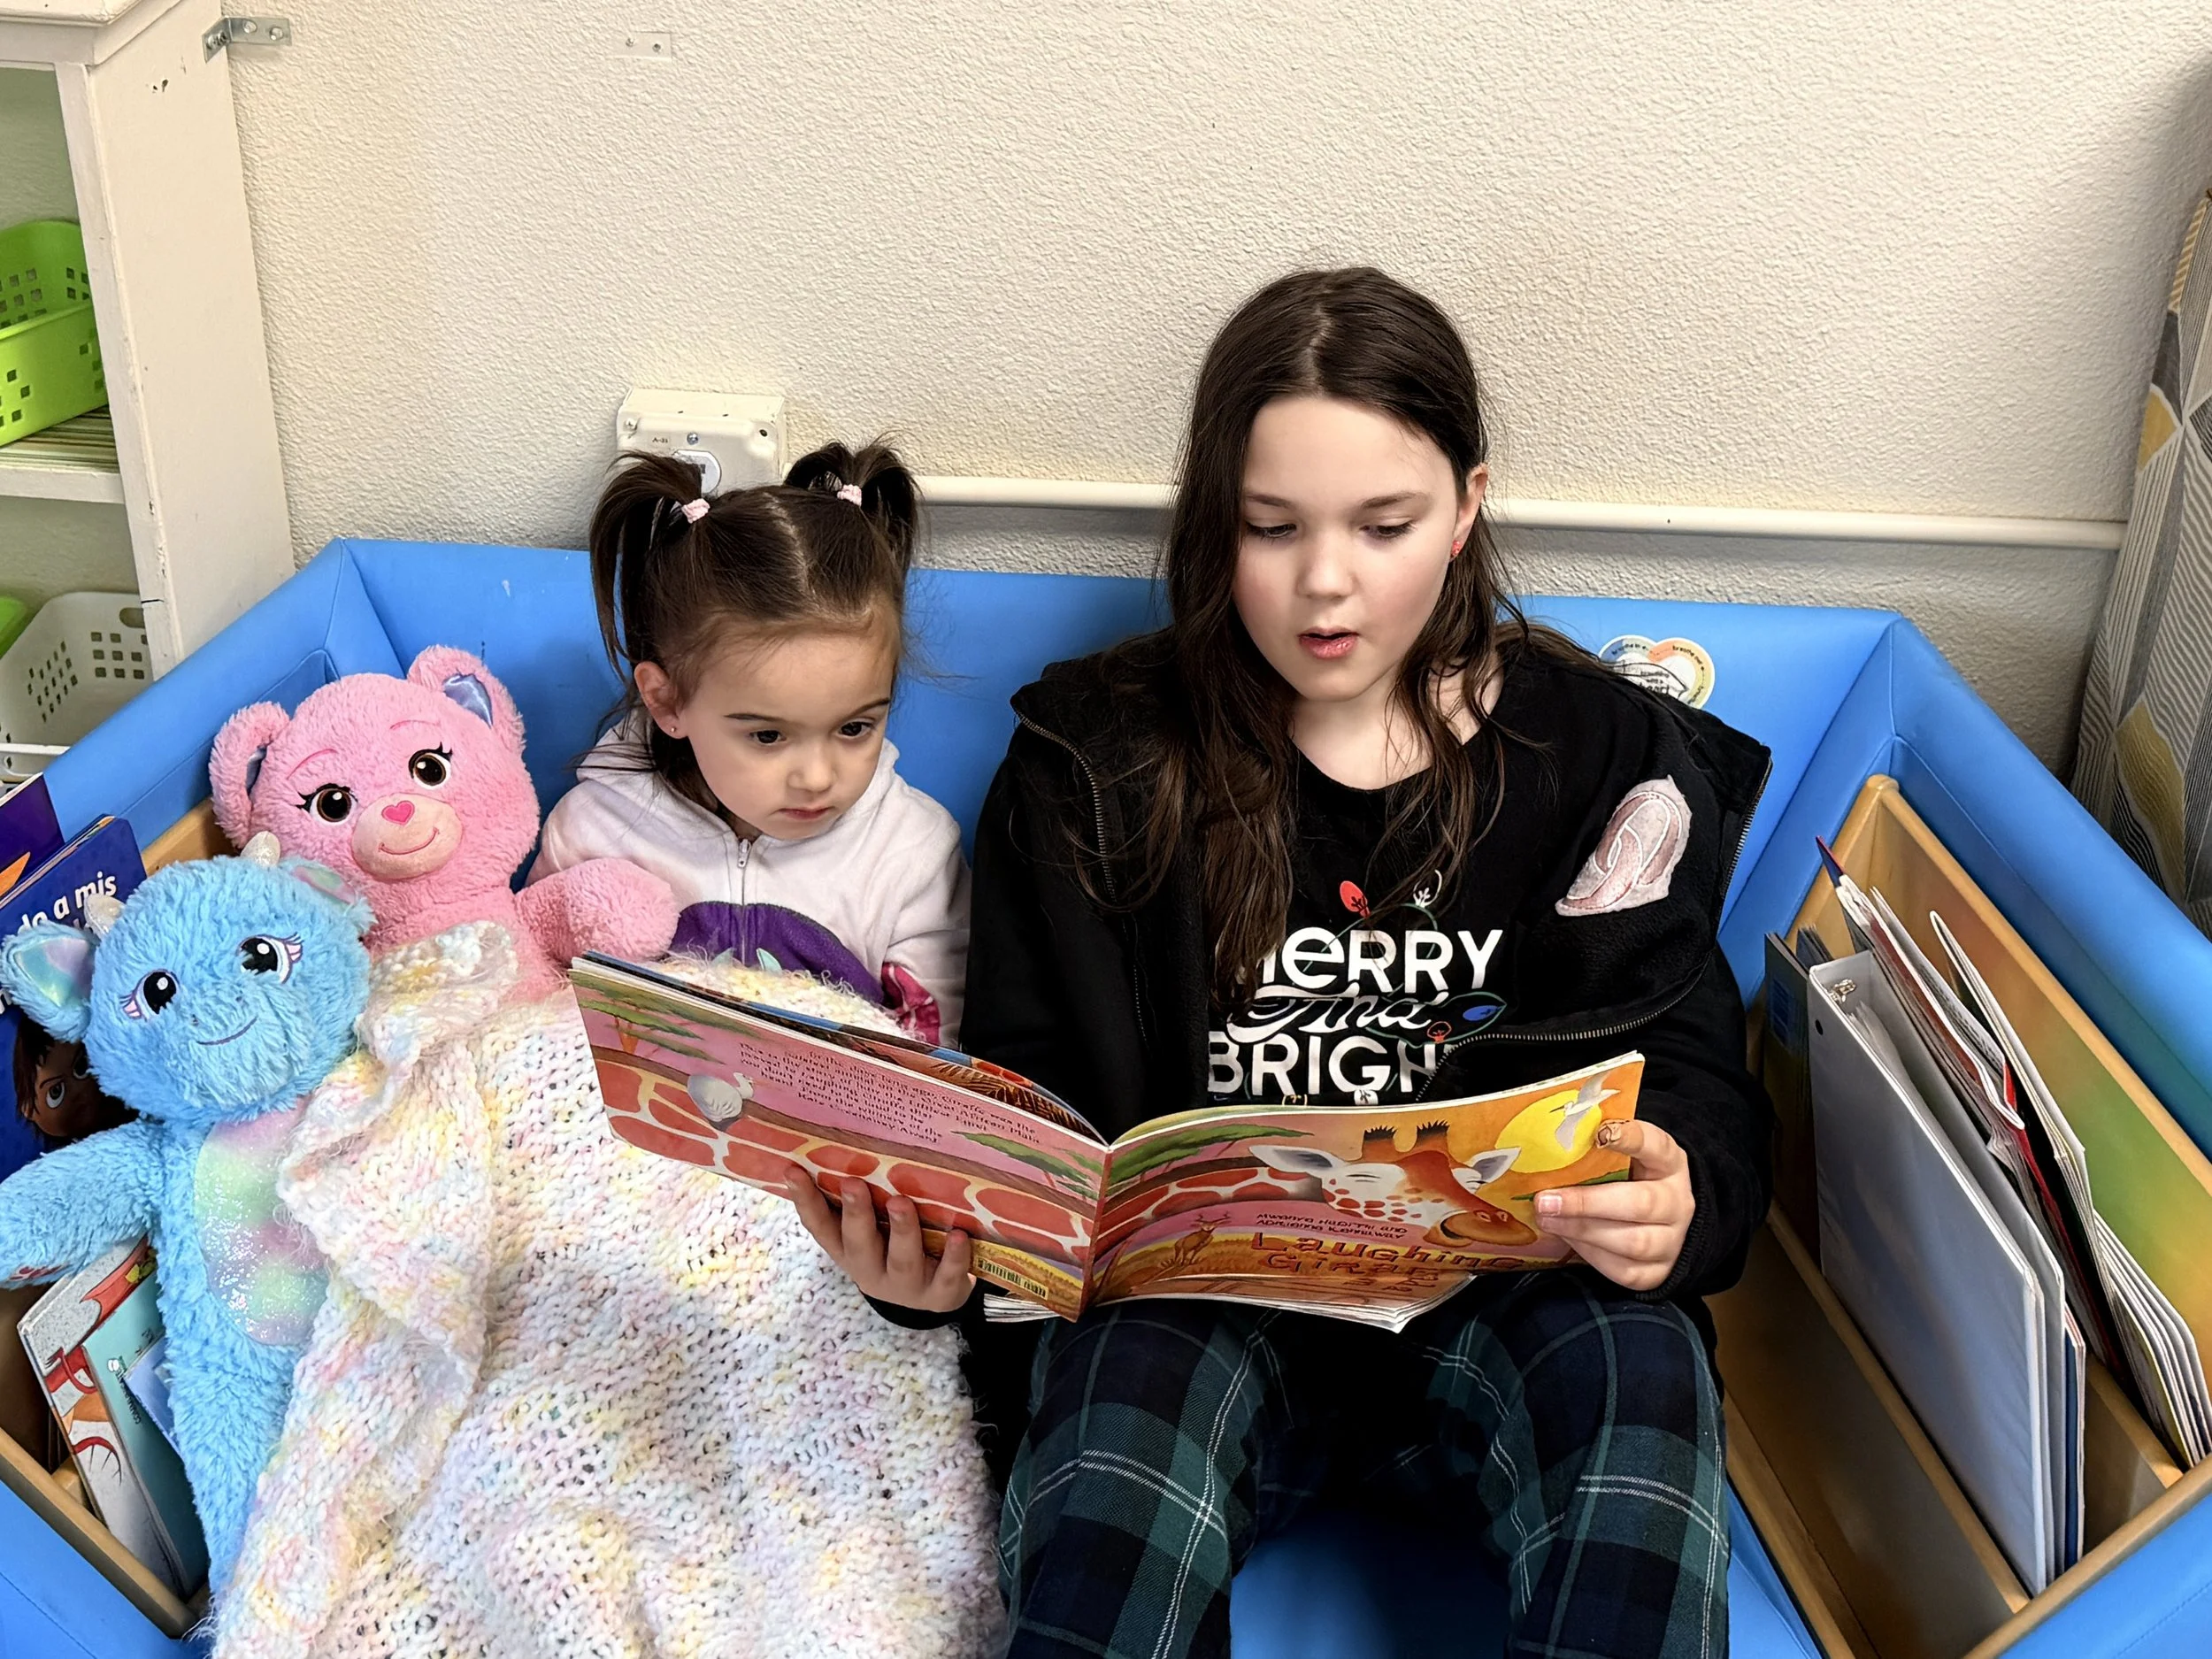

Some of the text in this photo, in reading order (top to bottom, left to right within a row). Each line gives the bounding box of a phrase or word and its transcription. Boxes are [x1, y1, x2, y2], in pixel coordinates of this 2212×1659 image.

[53, 895, 70, 919] a
[74, 871, 117, 909] mis
[1207, 1031, 1451, 1097] BRIGH
